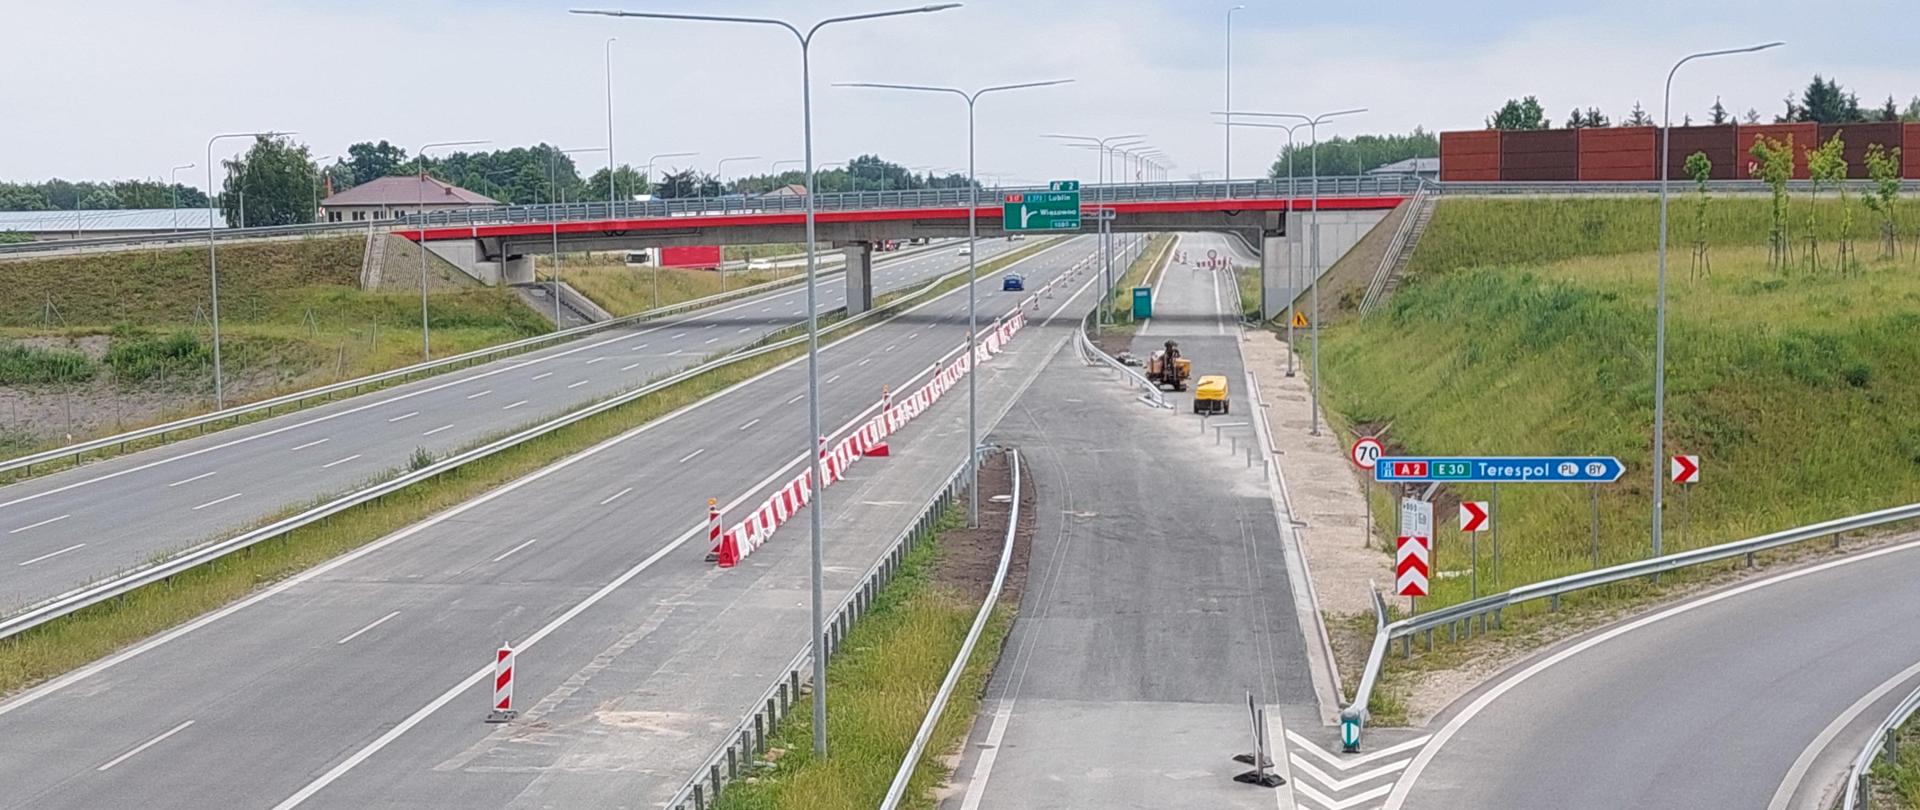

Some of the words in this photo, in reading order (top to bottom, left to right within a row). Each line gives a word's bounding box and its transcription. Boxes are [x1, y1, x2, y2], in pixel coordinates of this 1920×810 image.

[1068, 182, 1074, 190] 2
[1358, 446, 1378, 461] 70
[1401, 464, 1410, 474] A
[1413, 464, 1420, 474] 2
[1438, 464, 1445, 475] E
[1448, 464, 1465, 475] 30
[1478, 462, 1549, 480] Terespol
[1561, 464, 1575, 475] PL
[1588, 464, 1602, 475] BY
